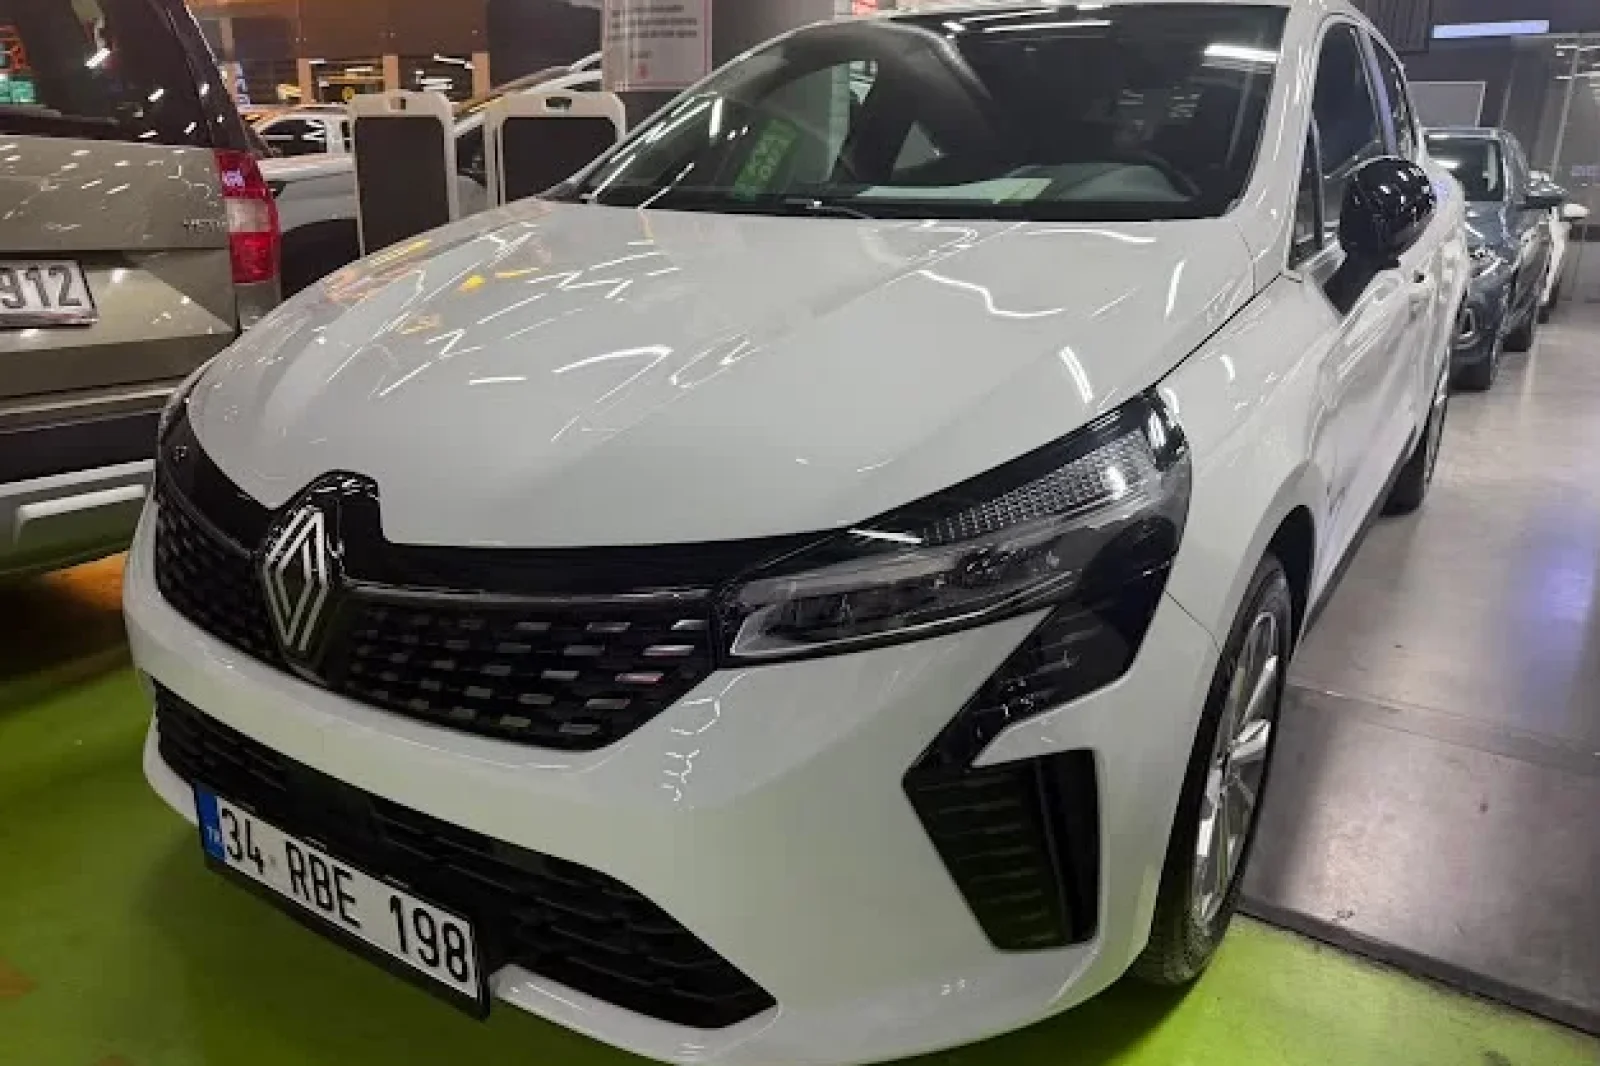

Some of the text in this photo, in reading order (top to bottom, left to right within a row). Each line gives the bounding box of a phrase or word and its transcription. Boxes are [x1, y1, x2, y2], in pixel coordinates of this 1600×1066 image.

[0, 264, 83, 309] 912
[221, 807, 469, 983] 34 RBE 198
